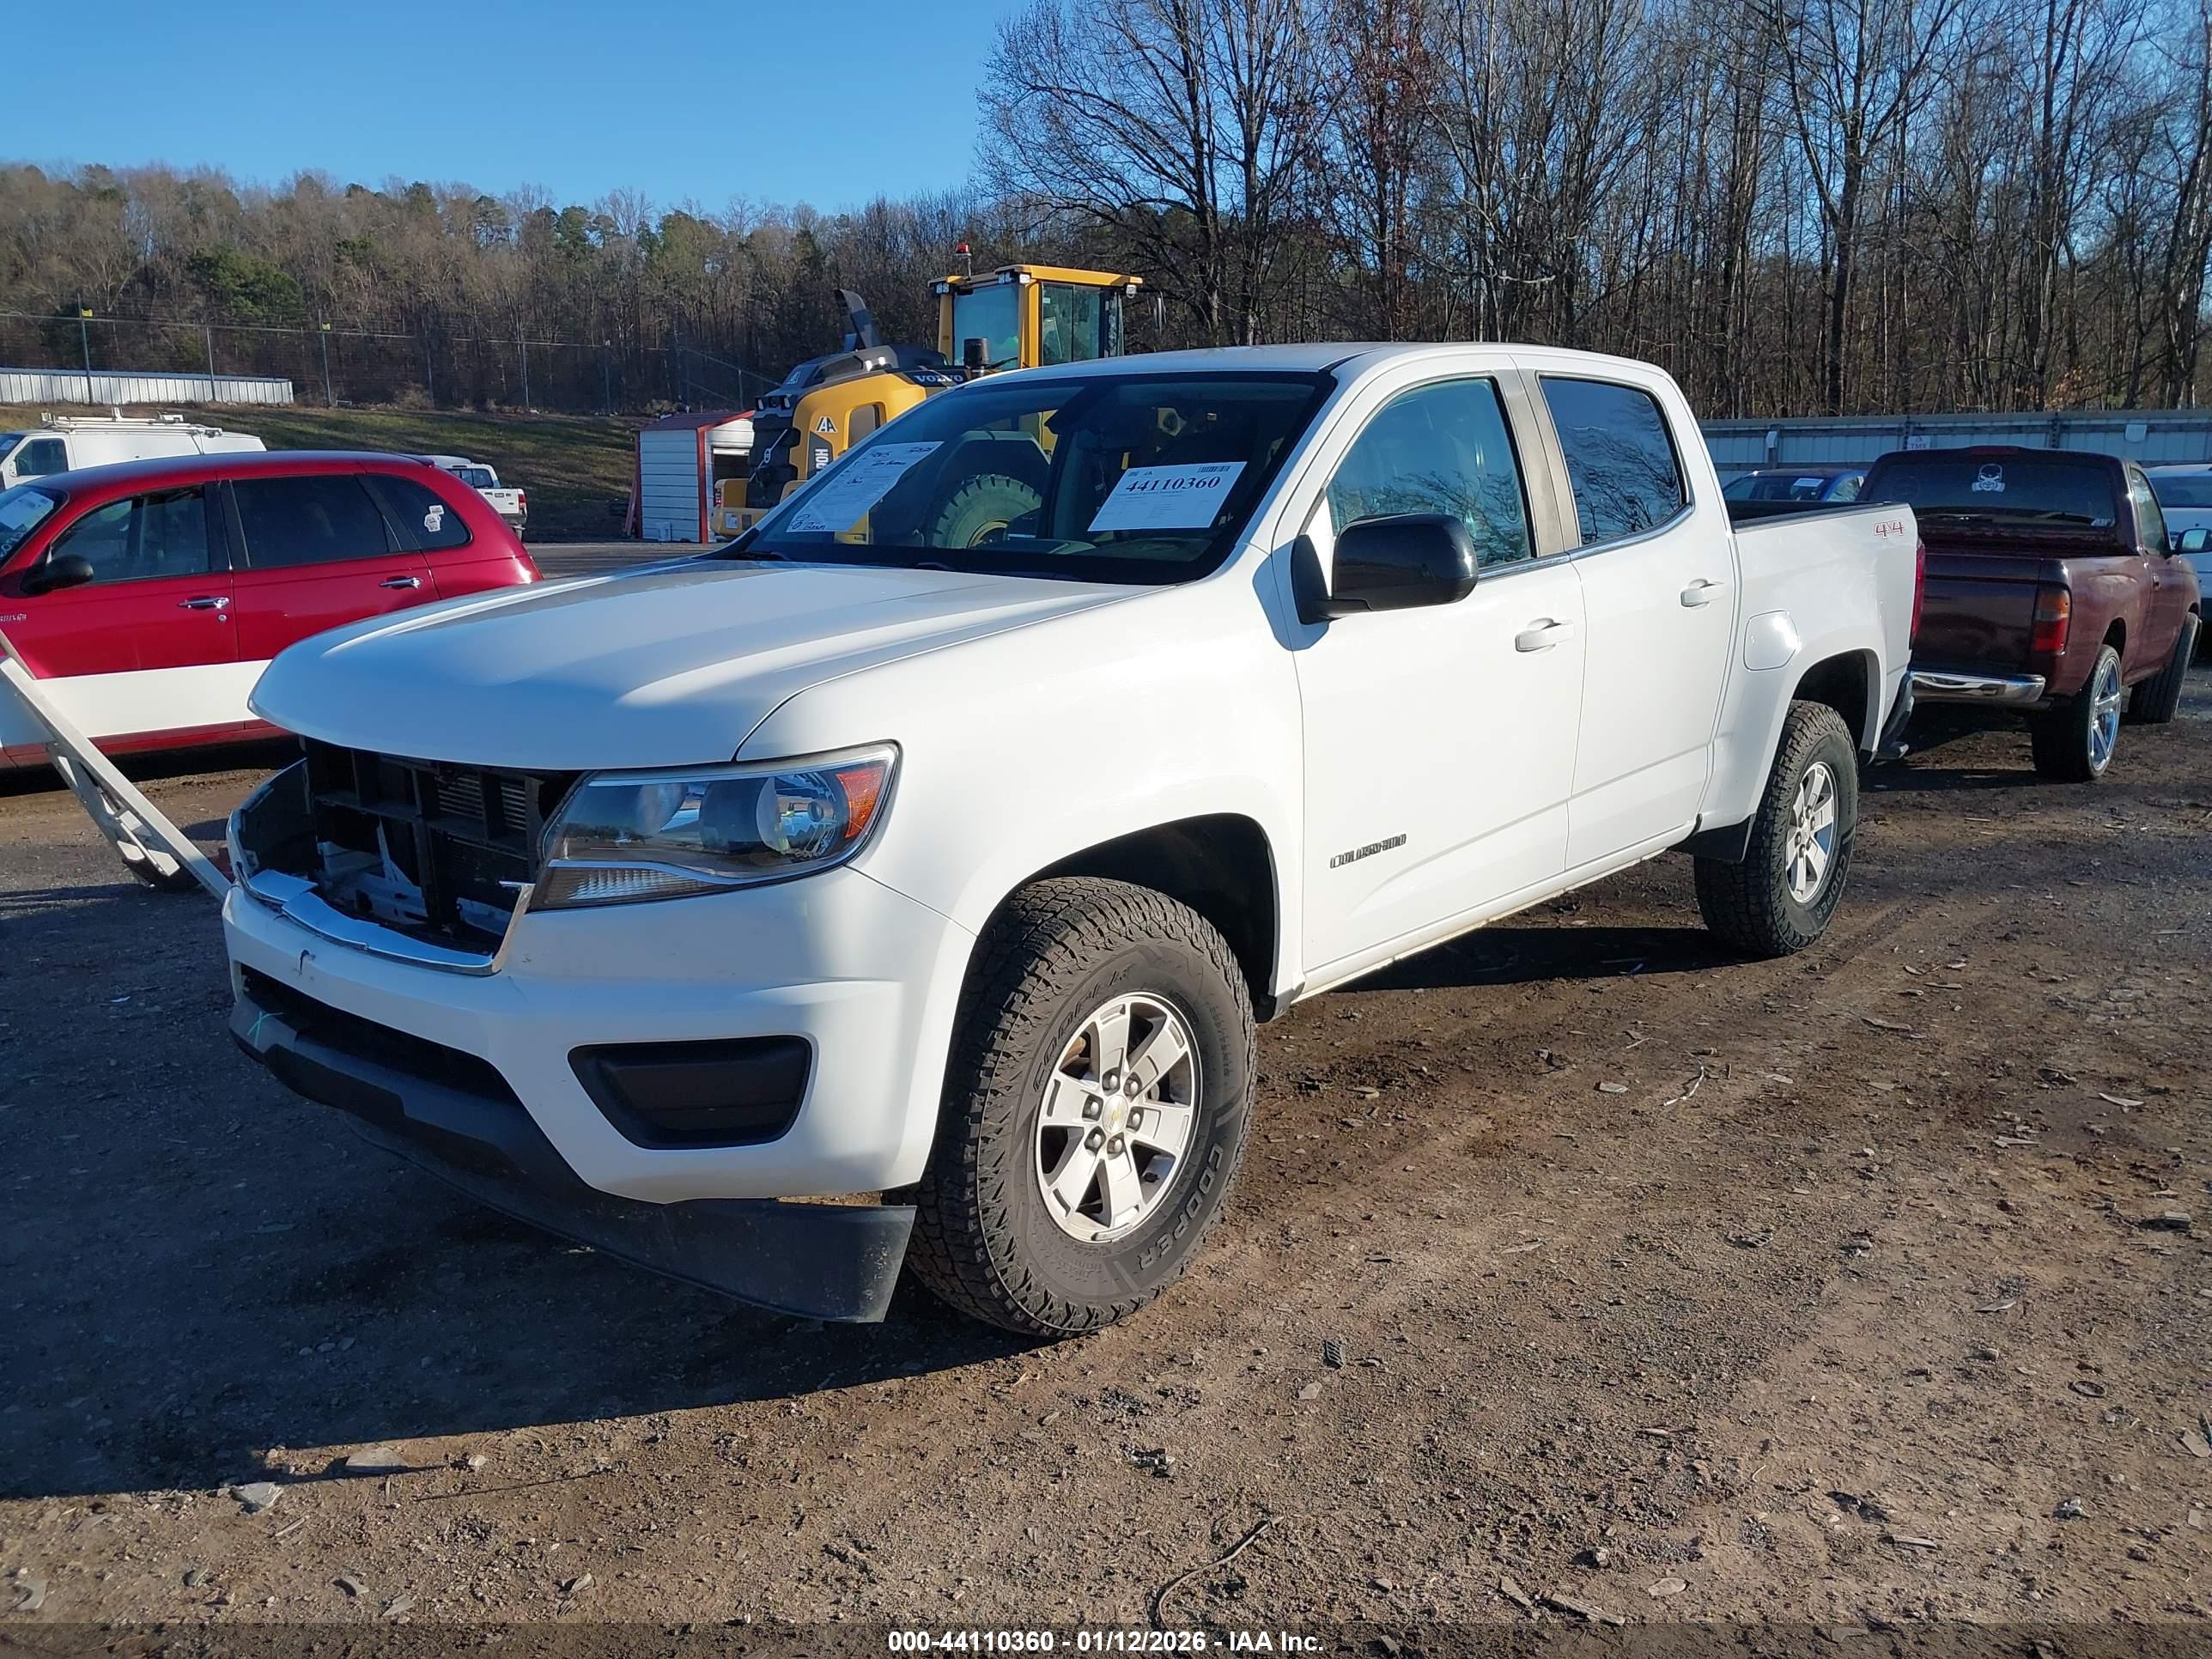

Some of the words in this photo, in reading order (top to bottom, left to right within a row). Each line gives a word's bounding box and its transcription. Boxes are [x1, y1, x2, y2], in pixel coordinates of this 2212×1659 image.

[915, 374, 963, 384] VOLVO
[1126, 477, 1221, 492] 44110360
[1816, 854, 1847, 919] COOPER
[1139, 1143, 1224, 1270] COOPER
